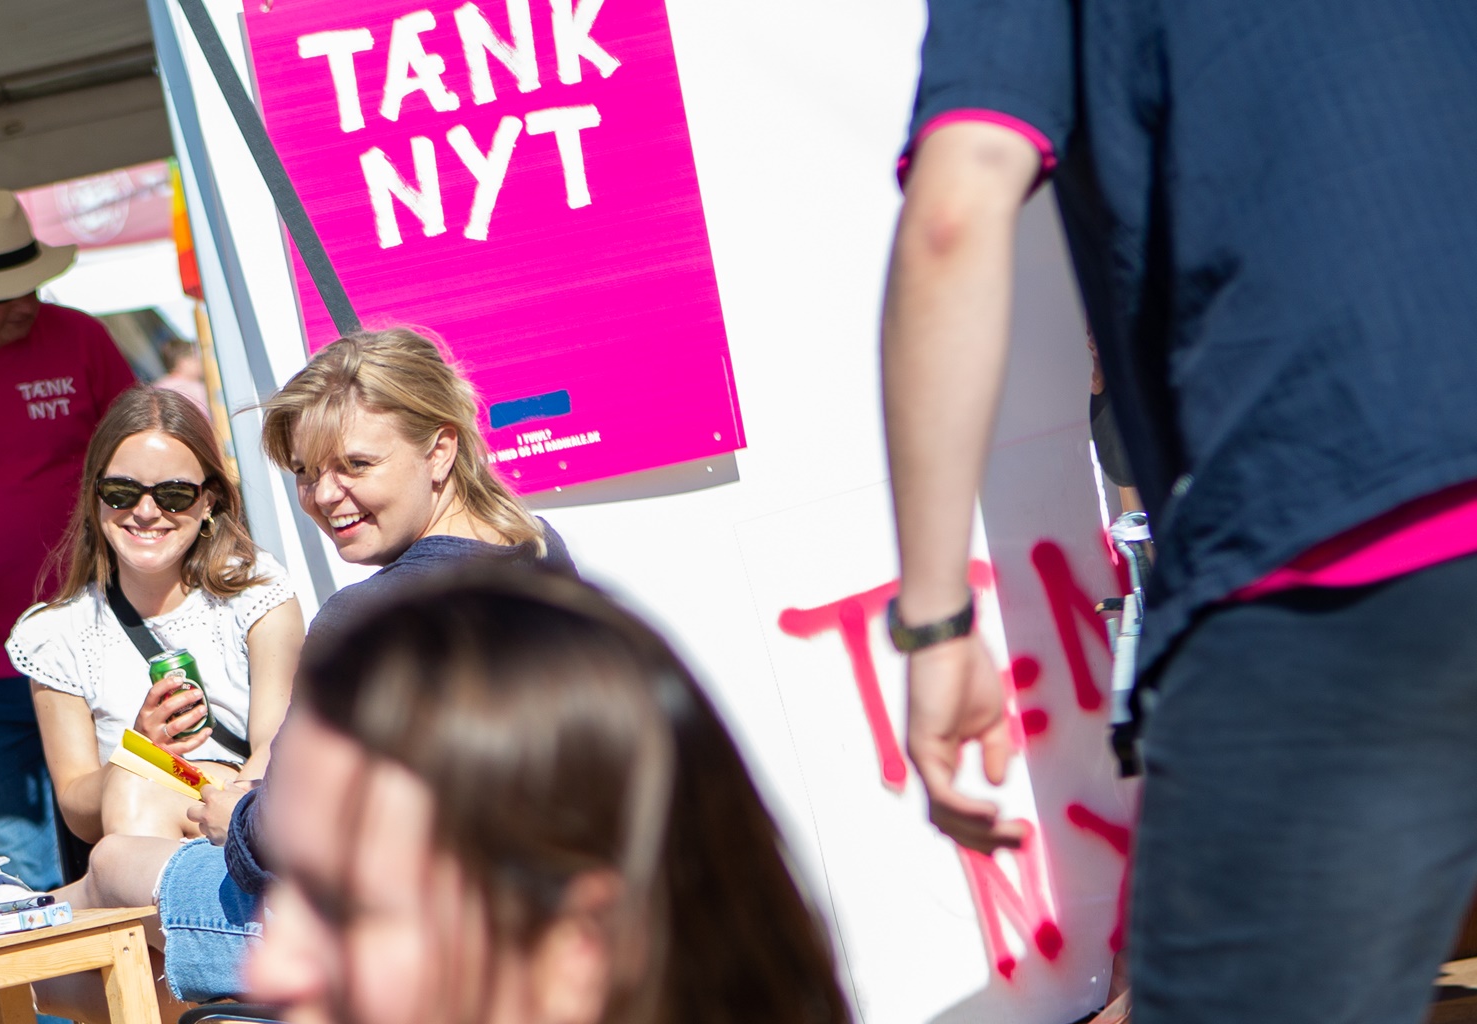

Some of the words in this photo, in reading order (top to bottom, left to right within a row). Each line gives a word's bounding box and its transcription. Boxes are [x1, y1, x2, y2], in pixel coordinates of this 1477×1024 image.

[297, 0, 622, 133] TÆNK
[359, 104, 601, 249] NYT
[15, 377, 76, 401] TÆNK
[27, 397, 70, 420] NYT
